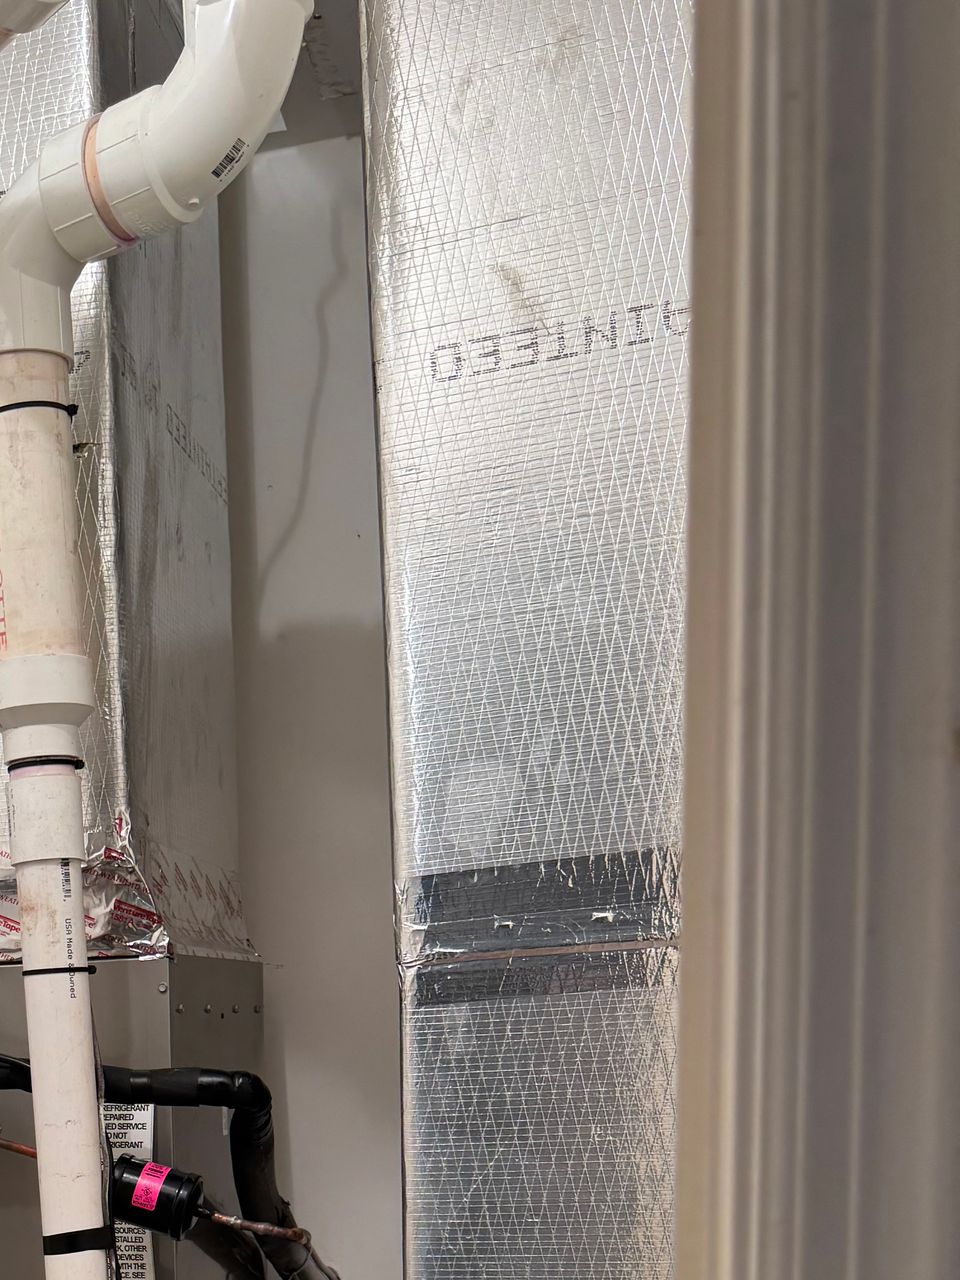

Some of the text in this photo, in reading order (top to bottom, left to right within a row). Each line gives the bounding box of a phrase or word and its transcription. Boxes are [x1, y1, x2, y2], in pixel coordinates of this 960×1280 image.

[64, 918, 72, 935] USA
[117, 1122, 147, 1130] SERVICE
[113, 1132, 128, 1140] NOT
[114, 1227, 146, 1235] SOURCES
[133, 1262, 147, 1270] THE
[132, 1271, 146, 1279] SEE
